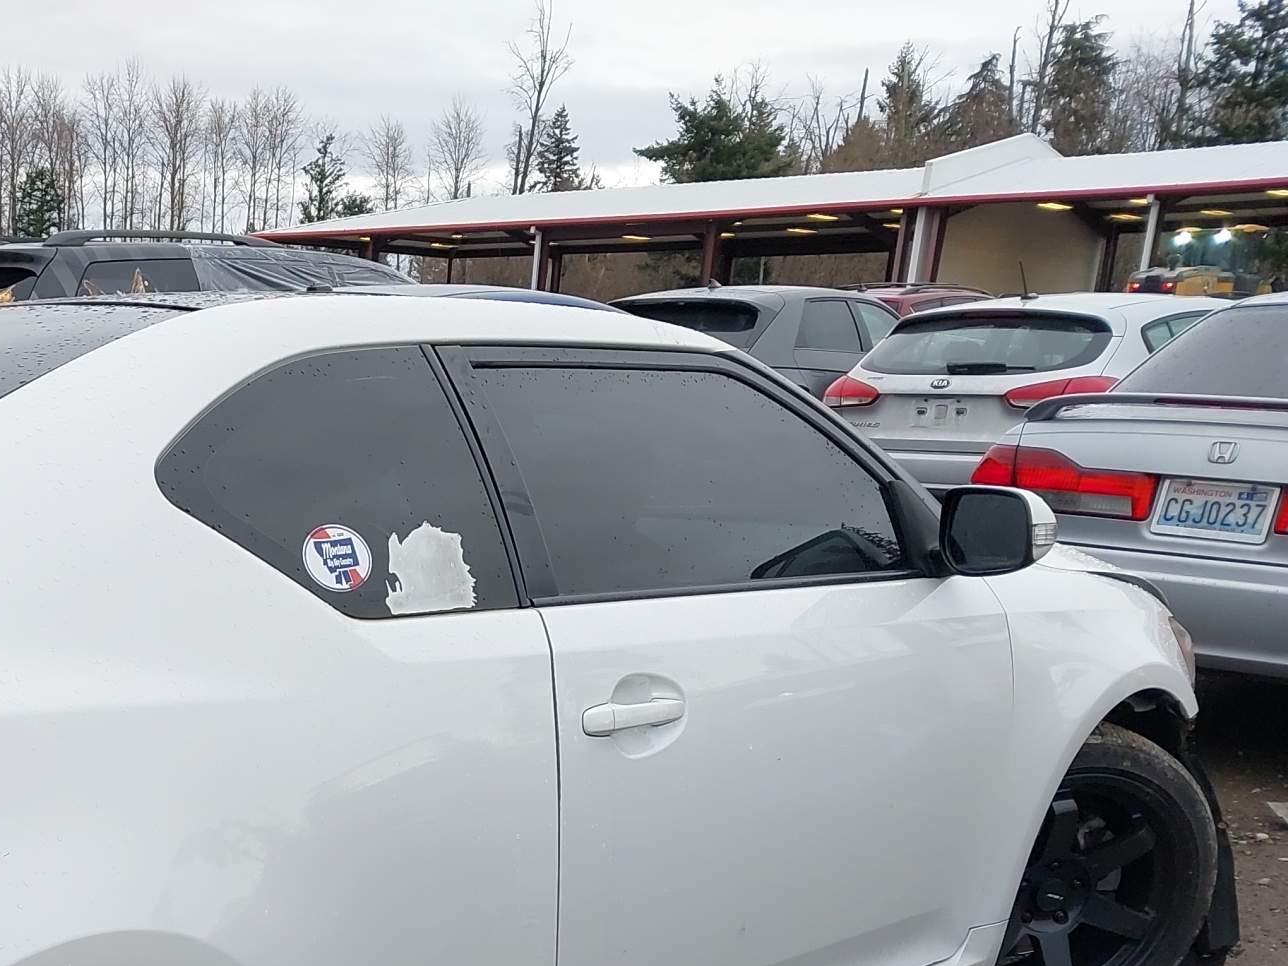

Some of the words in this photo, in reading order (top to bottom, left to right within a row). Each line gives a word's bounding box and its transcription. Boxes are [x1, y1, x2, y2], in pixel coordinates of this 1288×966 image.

[1172, 485, 1233, 498] WASHINGTON
[1163, 497, 1268, 530] CGJ0237
[321, 541, 352, 560] Montana
